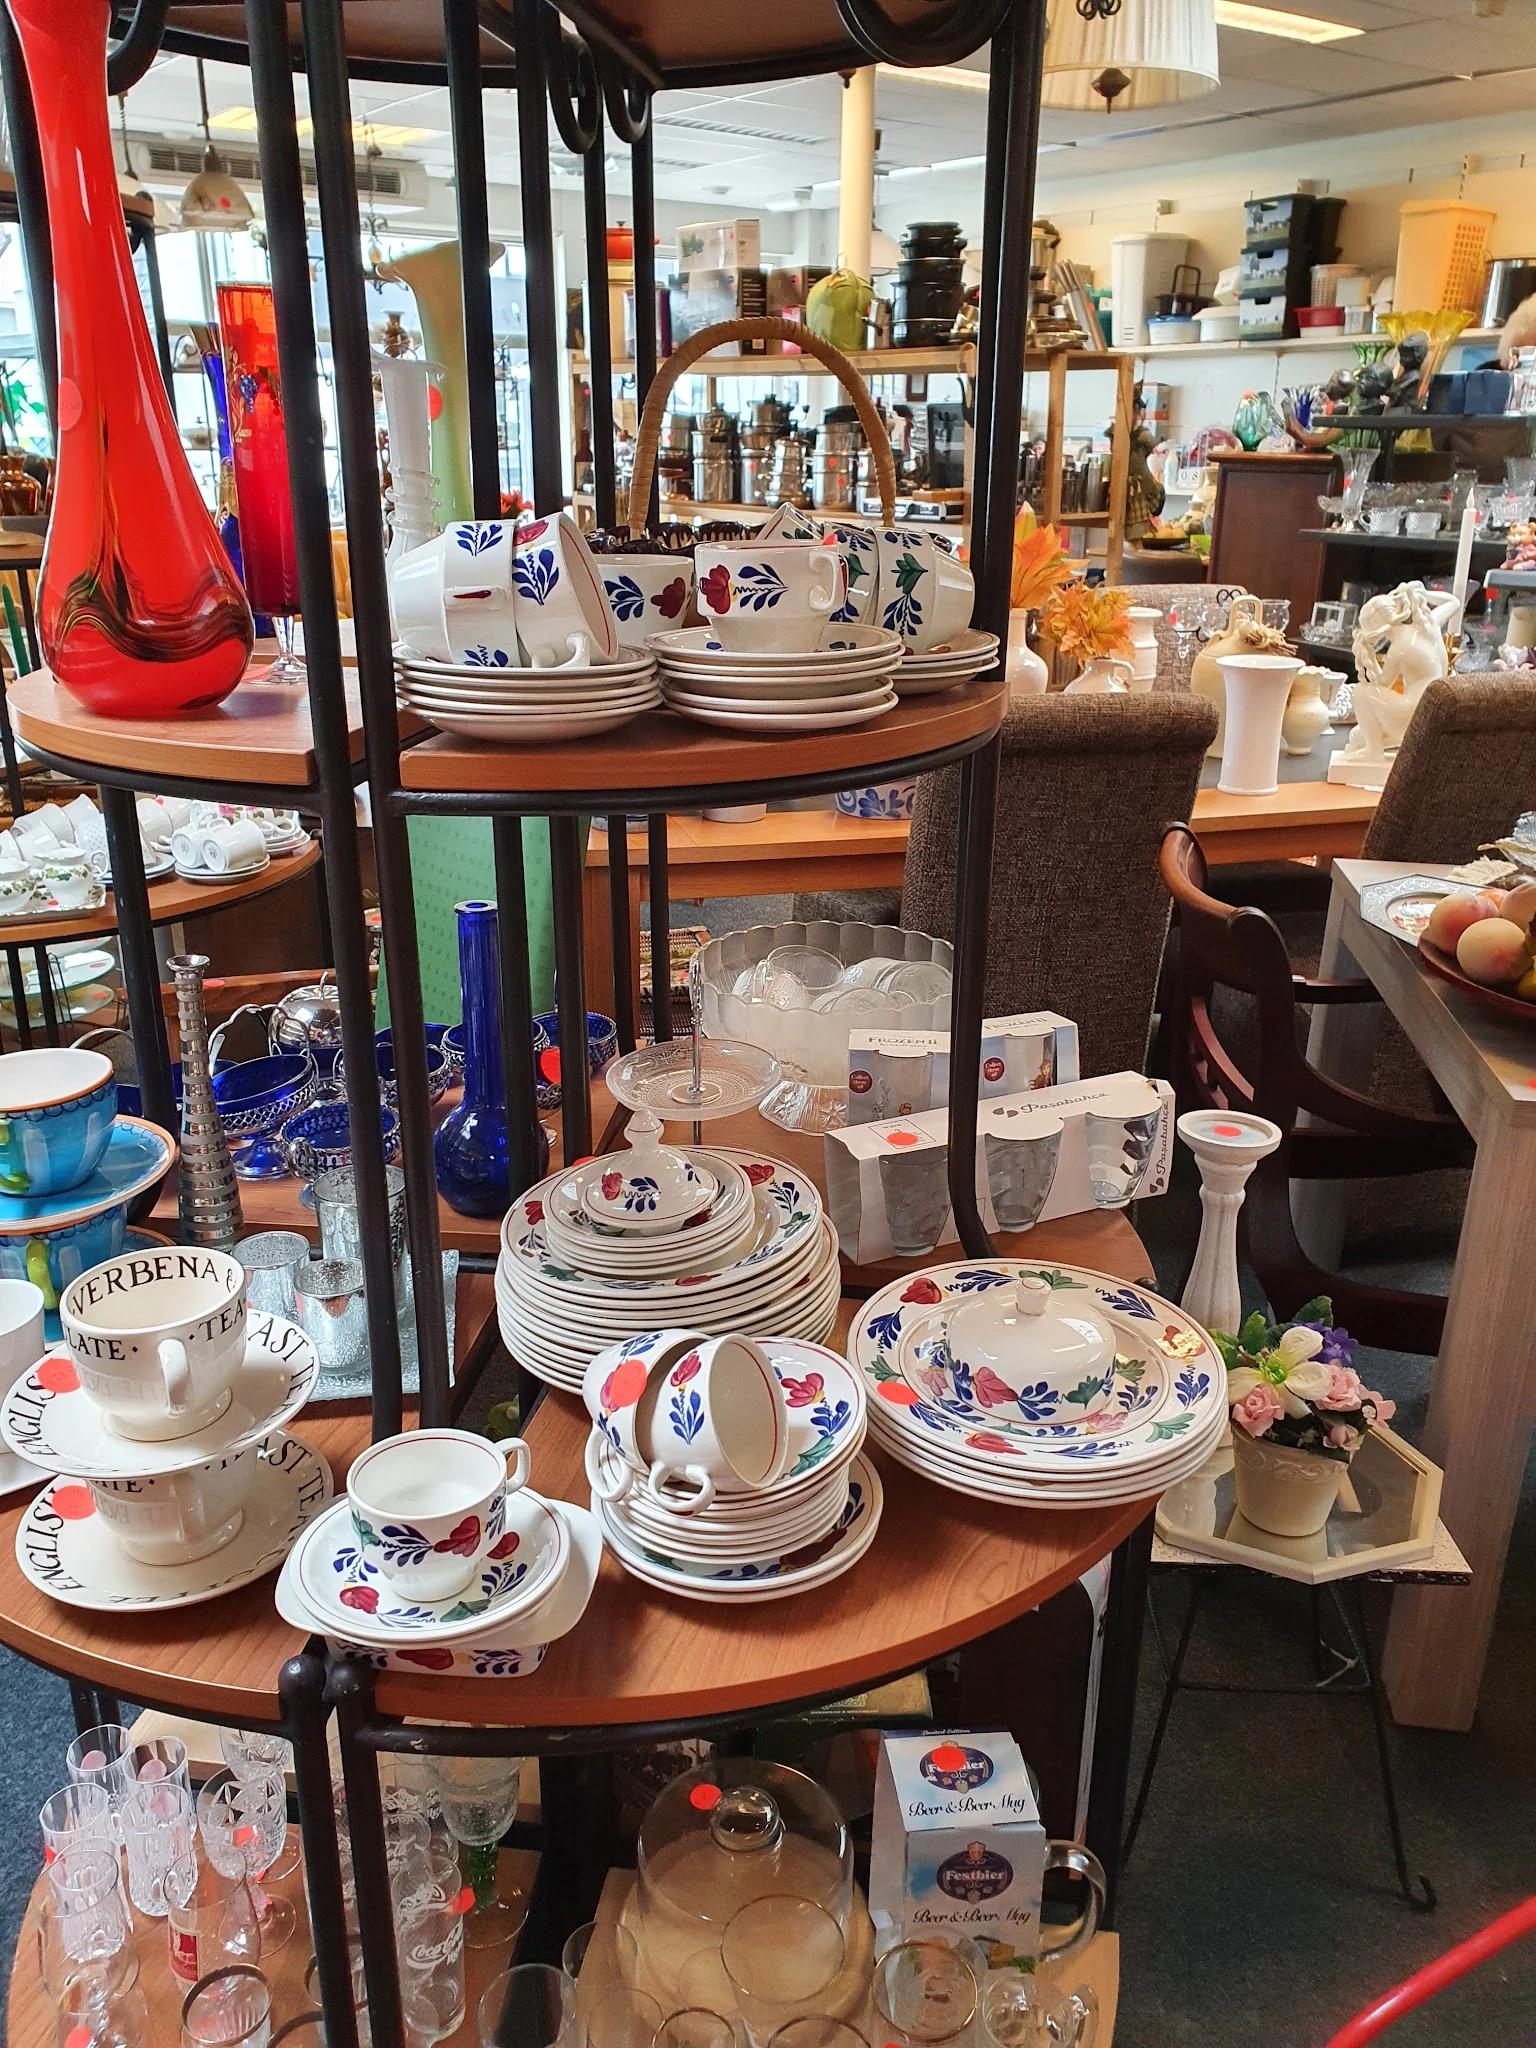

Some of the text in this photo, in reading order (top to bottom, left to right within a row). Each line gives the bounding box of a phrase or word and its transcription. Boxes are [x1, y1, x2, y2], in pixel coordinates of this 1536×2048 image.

[868, 1036, 925, 1044] FROZEN
[72, 1256, 219, 1315] VERBENA
[199, 1301, 244, 1342] TEA
[66, 1326, 126, 1360] LATE
[8, 1371, 61, 1456] ENGLIS
[248, 1313, 309, 1362] AST
[26, 1487, 87, 1591] ENGLIS
[909, 1802, 943, 1816] Beer
[959, 1797, 996, 1812] Beer
[1001, 1793, 1025, 1813] Mug
[945, 1870, 1005, 1880] Festbier
[913, 1909, 947, 1923] Beer
[964, 1908, 999, 1922] Beer
[1005, 1907, 1031, 1926] Mug
